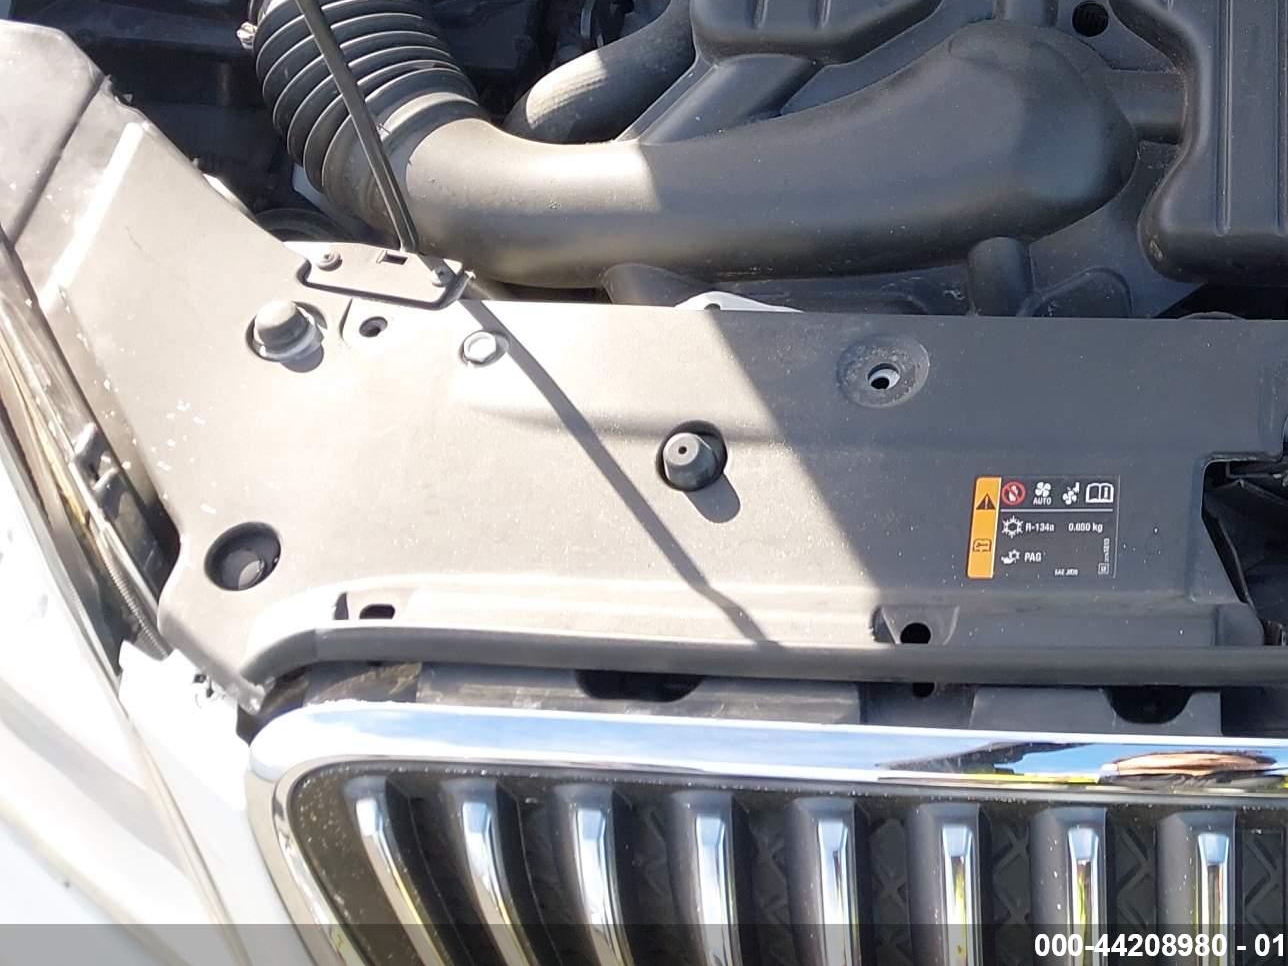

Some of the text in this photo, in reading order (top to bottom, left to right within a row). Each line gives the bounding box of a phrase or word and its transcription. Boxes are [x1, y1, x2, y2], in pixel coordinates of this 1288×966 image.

[1033, 497, 1052, 506] AUTO
[1025, 522, 1055, 533] R-134a
[1092, 522, 1103, 534] kg
[1024, 552, 1042, 563] PAG
